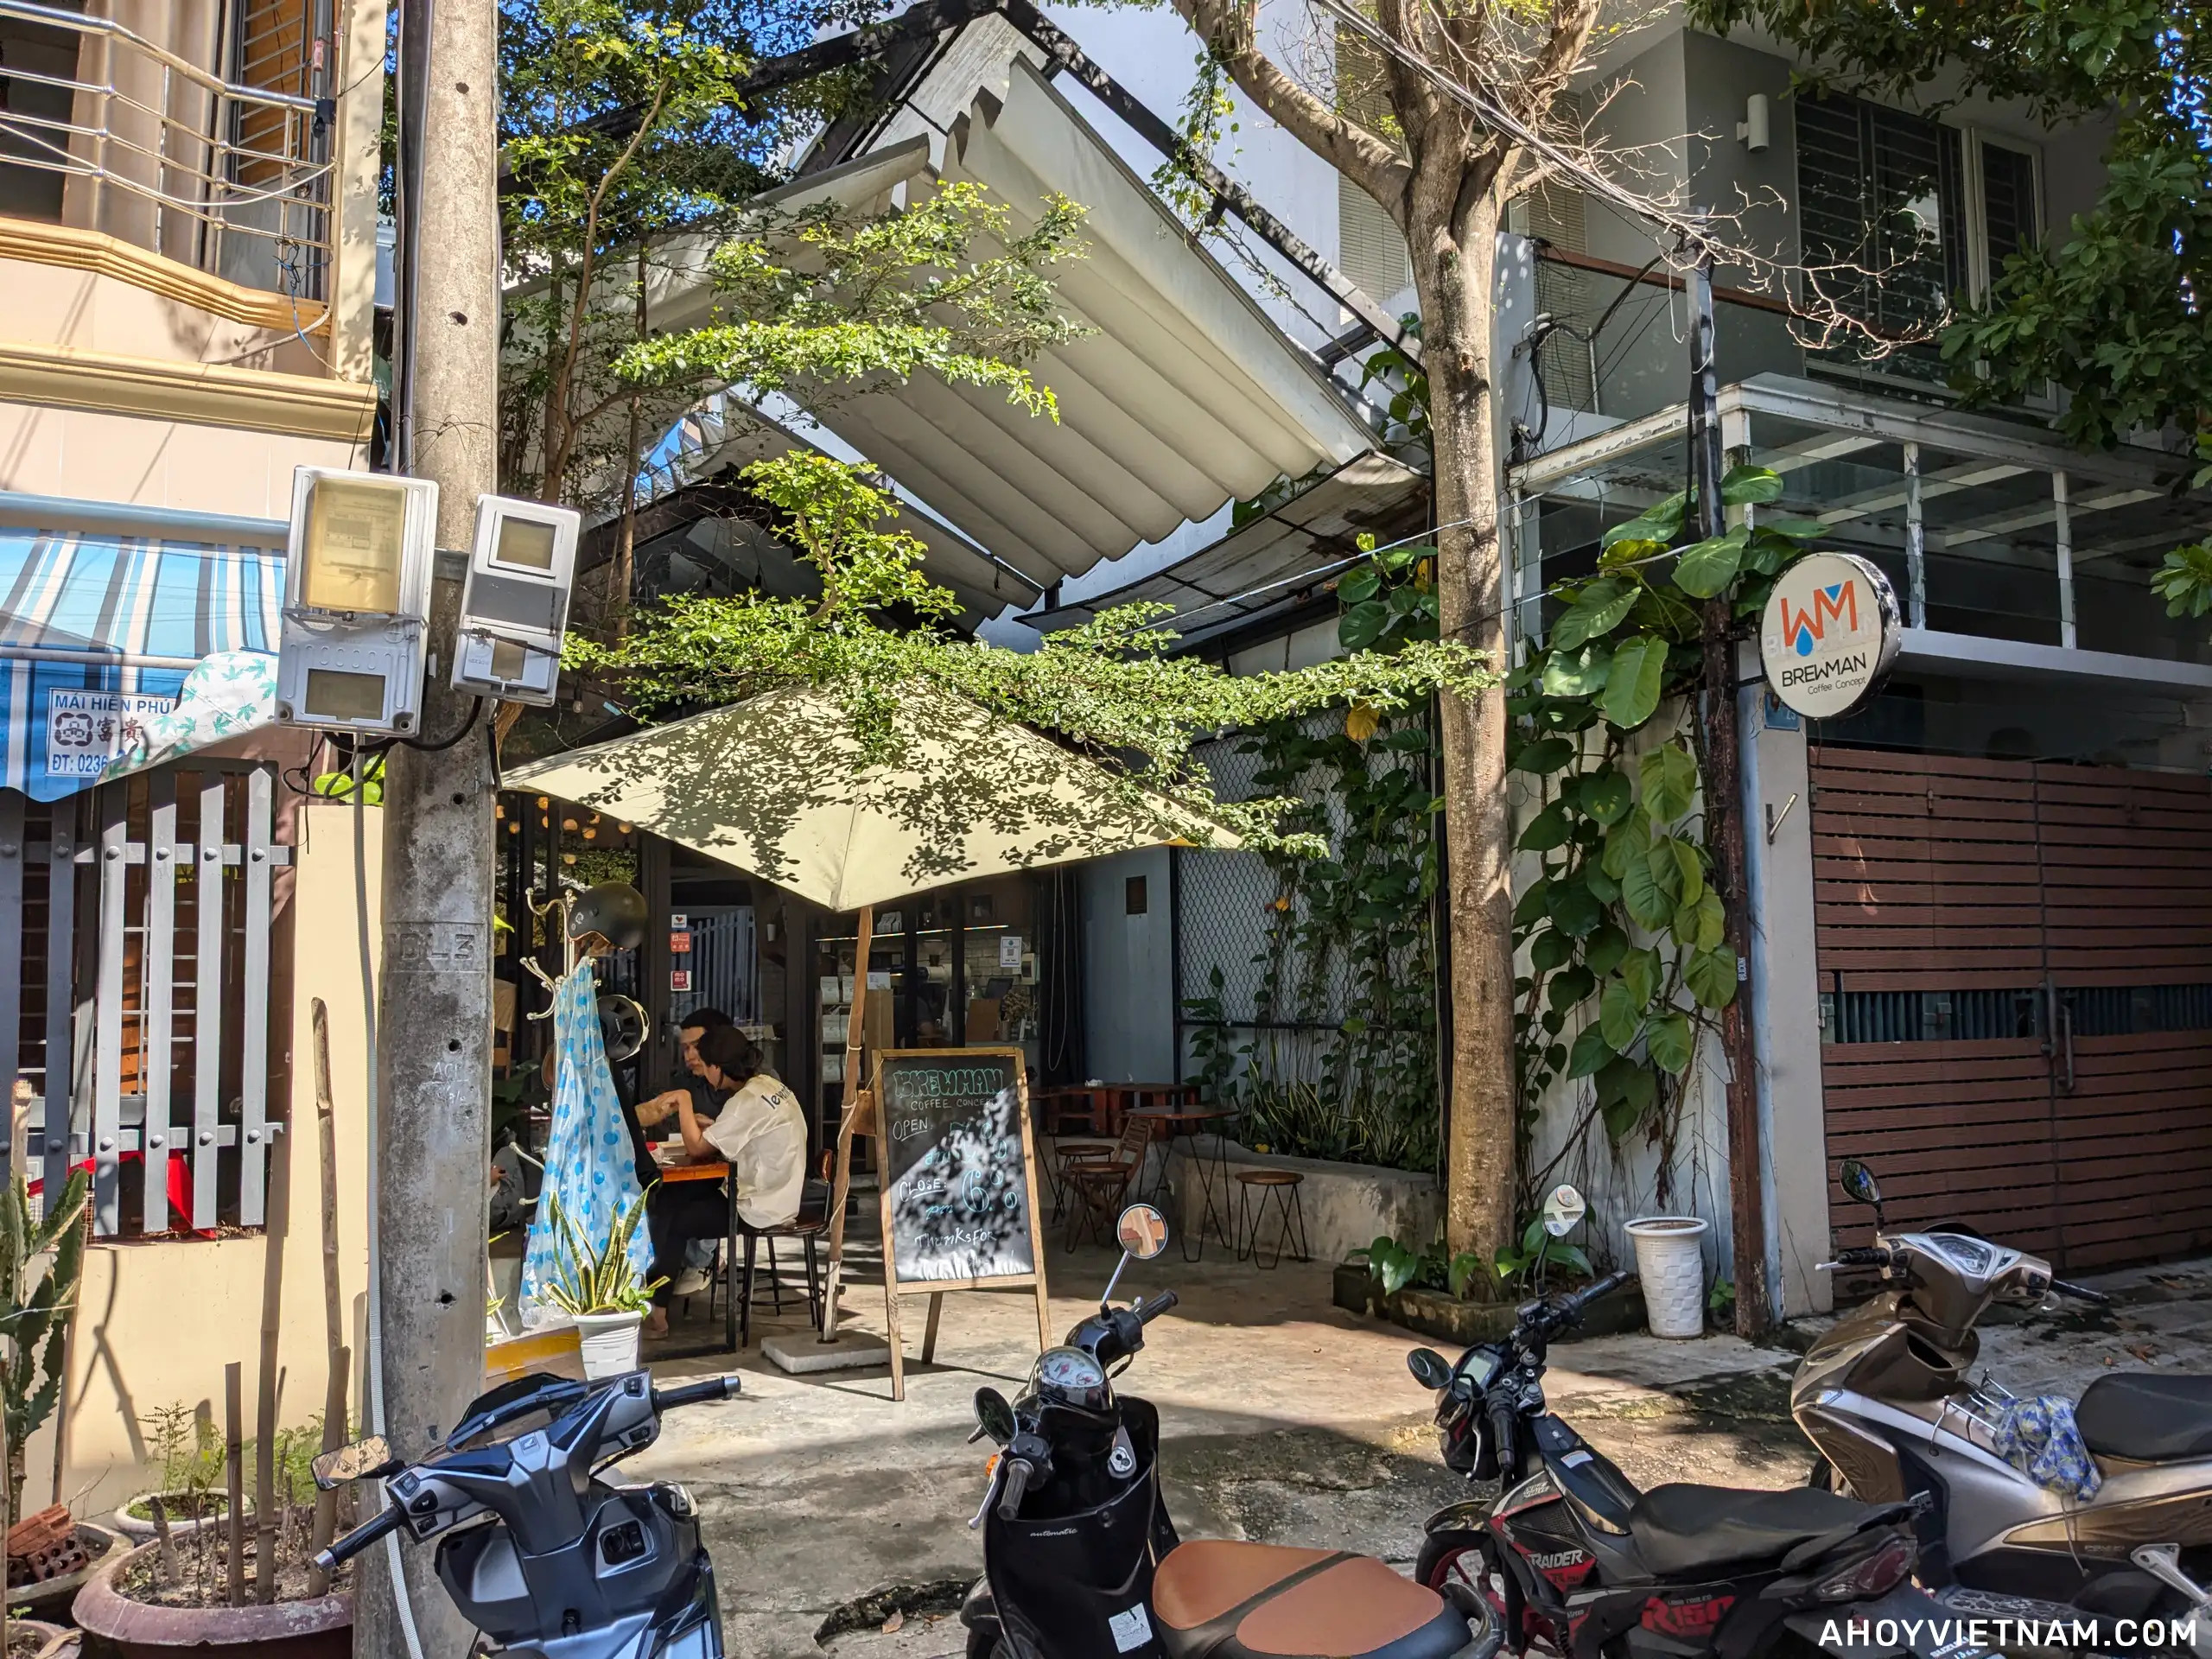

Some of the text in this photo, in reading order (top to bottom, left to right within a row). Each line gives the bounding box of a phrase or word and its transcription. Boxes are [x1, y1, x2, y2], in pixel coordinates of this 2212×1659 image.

[1782, 652, 1866, 687] BREWMAN
[1808, 676, 1866, 695] Coffee Concept
[55, 693, 170, 715] MÁI HIÊN PHÚ
[53, 753, 73, 772] ĐT:
[893, 1069, 1003, 1098] BREWMAN
[911, 1098, 952, 1111] COFFEE
[925, 1204, 953, 1220] pm
[1030, 1528, 1077, 1537] automatic
[1527, 1549, 1584, 1569] RAIDER
